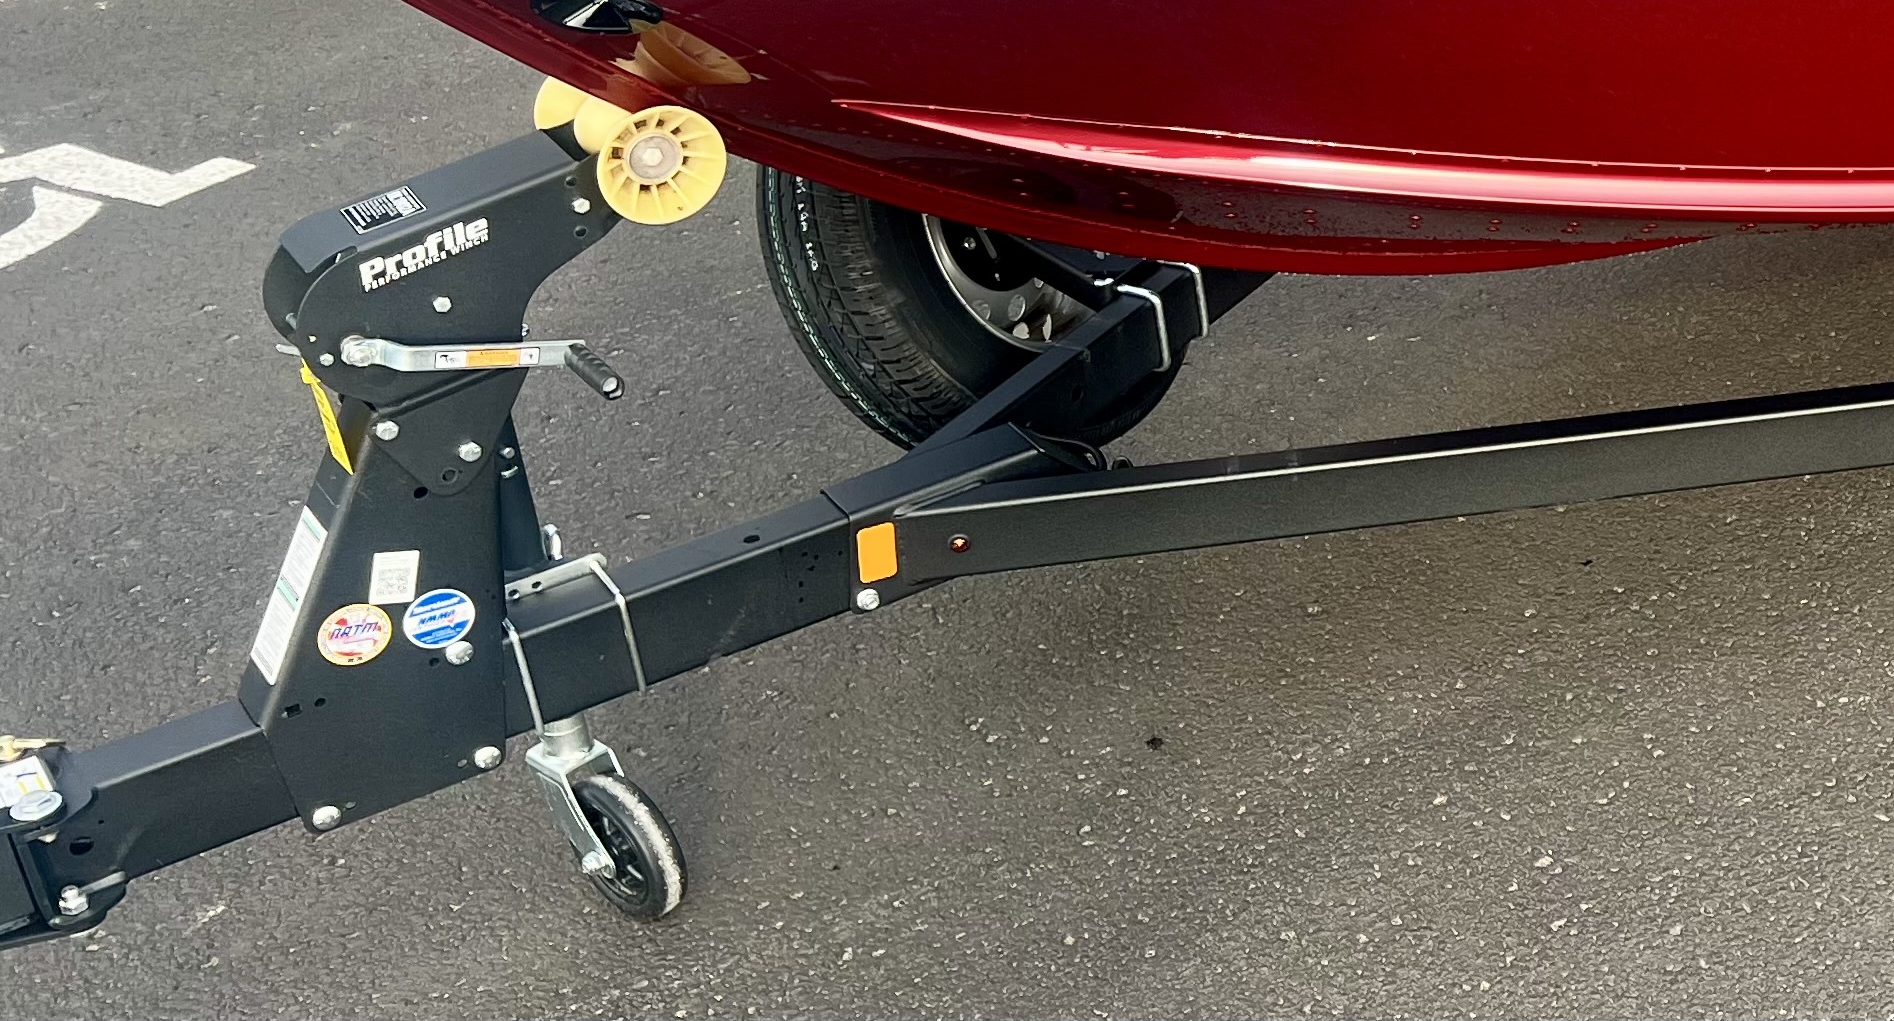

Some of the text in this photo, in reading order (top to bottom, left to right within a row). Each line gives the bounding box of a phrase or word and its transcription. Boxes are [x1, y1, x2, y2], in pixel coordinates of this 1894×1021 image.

[358, 217, 490, 287] Profile
[363, 233, 490, 293] PERFORMANCE WINCH
